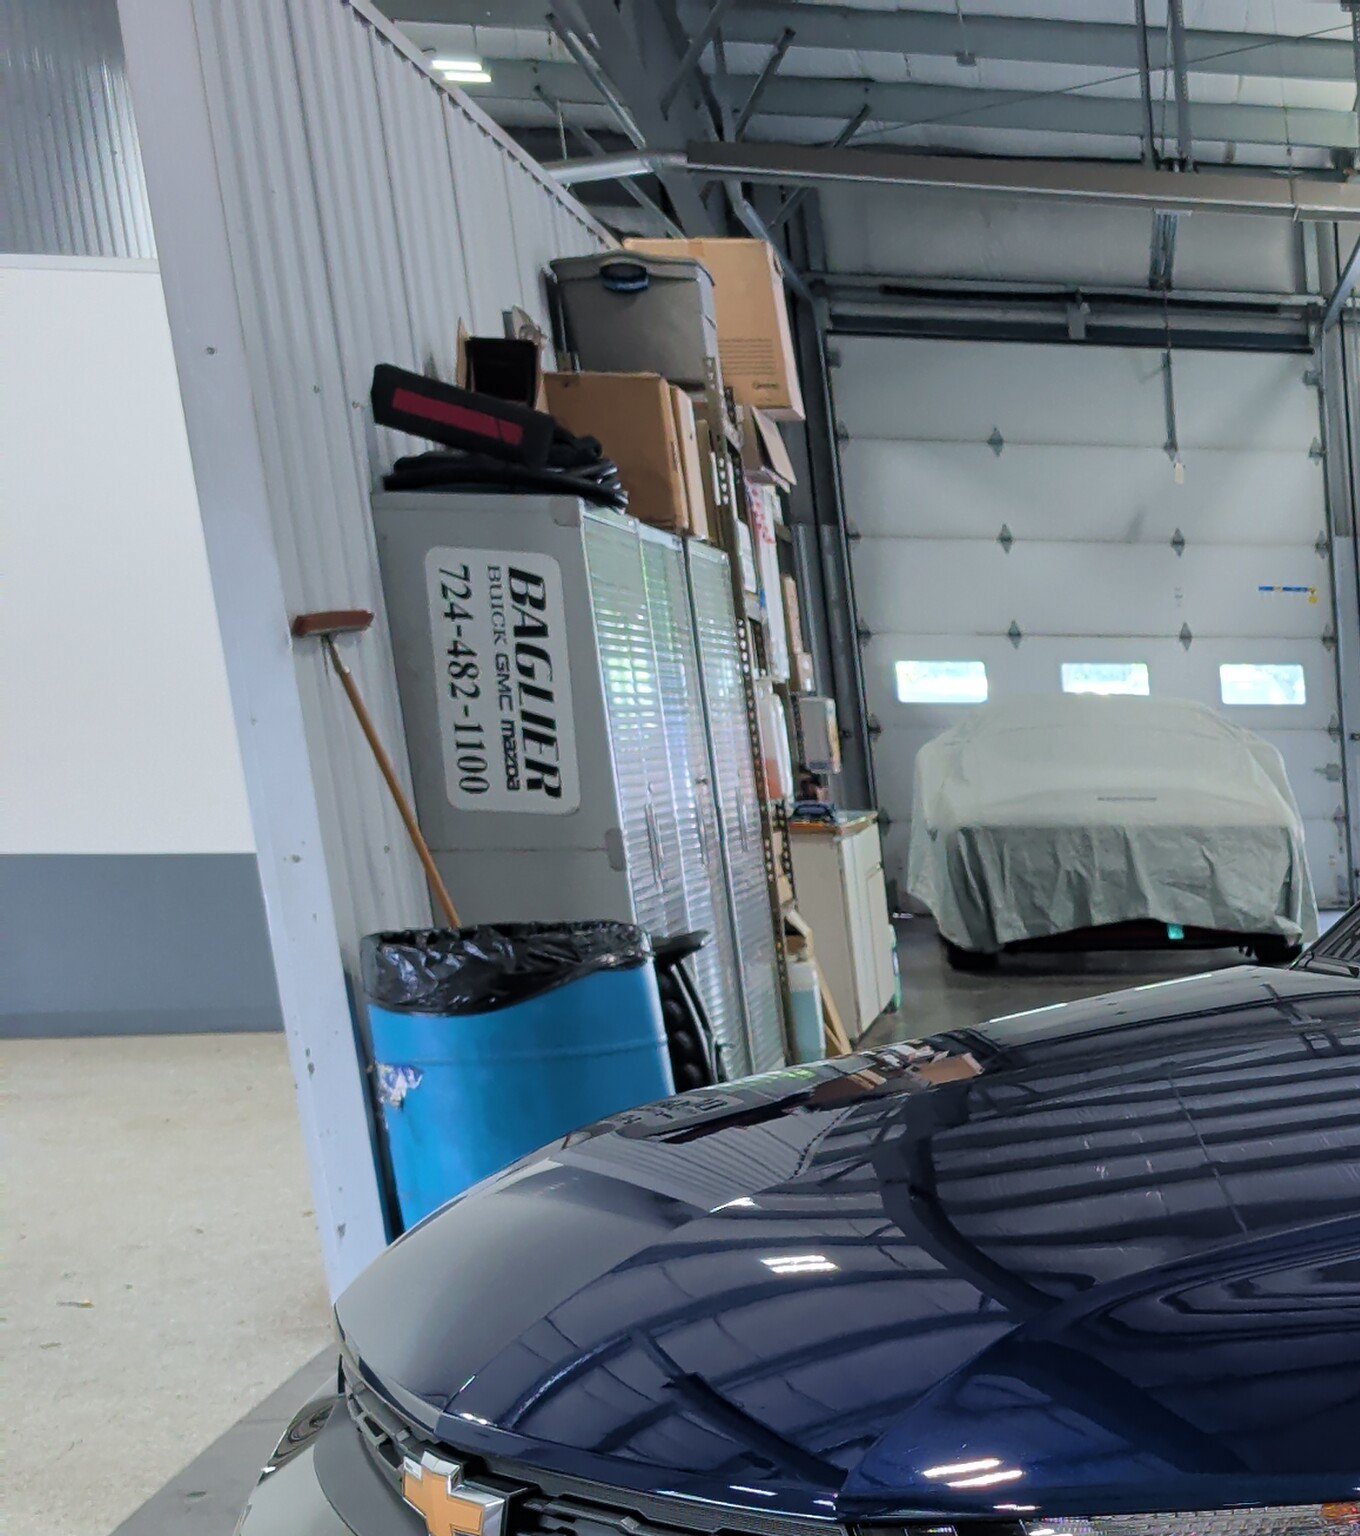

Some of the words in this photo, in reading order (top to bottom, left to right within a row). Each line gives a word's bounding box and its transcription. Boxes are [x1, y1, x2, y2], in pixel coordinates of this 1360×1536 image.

[439, 562, 491, 795] 724-482-1100
[487, 564, 507, 646] BUICK
[494, 652, 514, 712] GMC
[507, 566, 563, 799] BAGLIER
